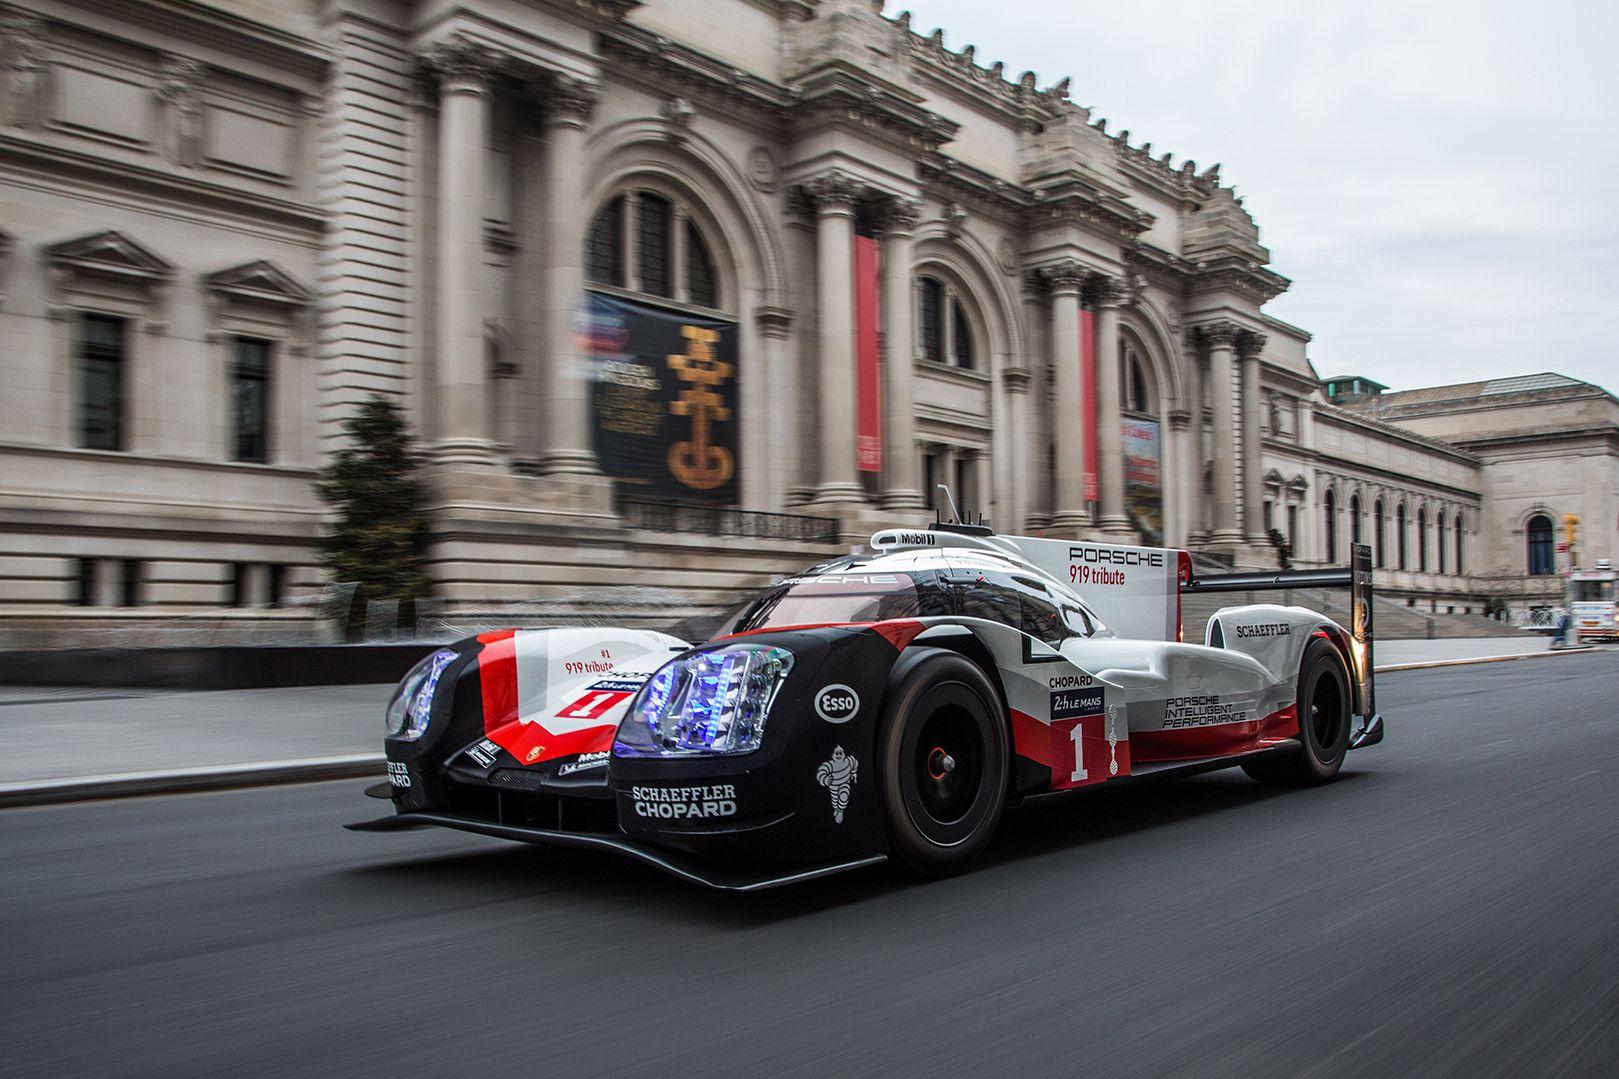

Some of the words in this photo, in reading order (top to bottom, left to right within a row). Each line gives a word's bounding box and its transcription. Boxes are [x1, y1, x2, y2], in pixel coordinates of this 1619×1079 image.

[901, 533, 926, 545] Mobil
[1069, 547, 1163, 567] PORSCHE
[1069, 565, 1089, 583] 919
[1092, 567, 1125, 585] tribute
[1236, 623, 1291, 638] SCHAEFFLER
[565, 662, 583, 674] 919
[1049, 676, 1092, 688] CHOPARD
[568, 692, 615, 717] 1
[1070, 699, 1079, 708] LE
[1080, 697, 1101, 707] MANS
[1166, 696, 1219, 708] PORSCHE
[1165, 704, 1233, 719] INTELLIGENT
[1162, 712, 1246, 729] PERFORMANCE
[1070, 723, 1088, 782] 1
[632, 785, 736, 801] SCHAEFFLER
[635, 801, 737, 818] CHOPARD
